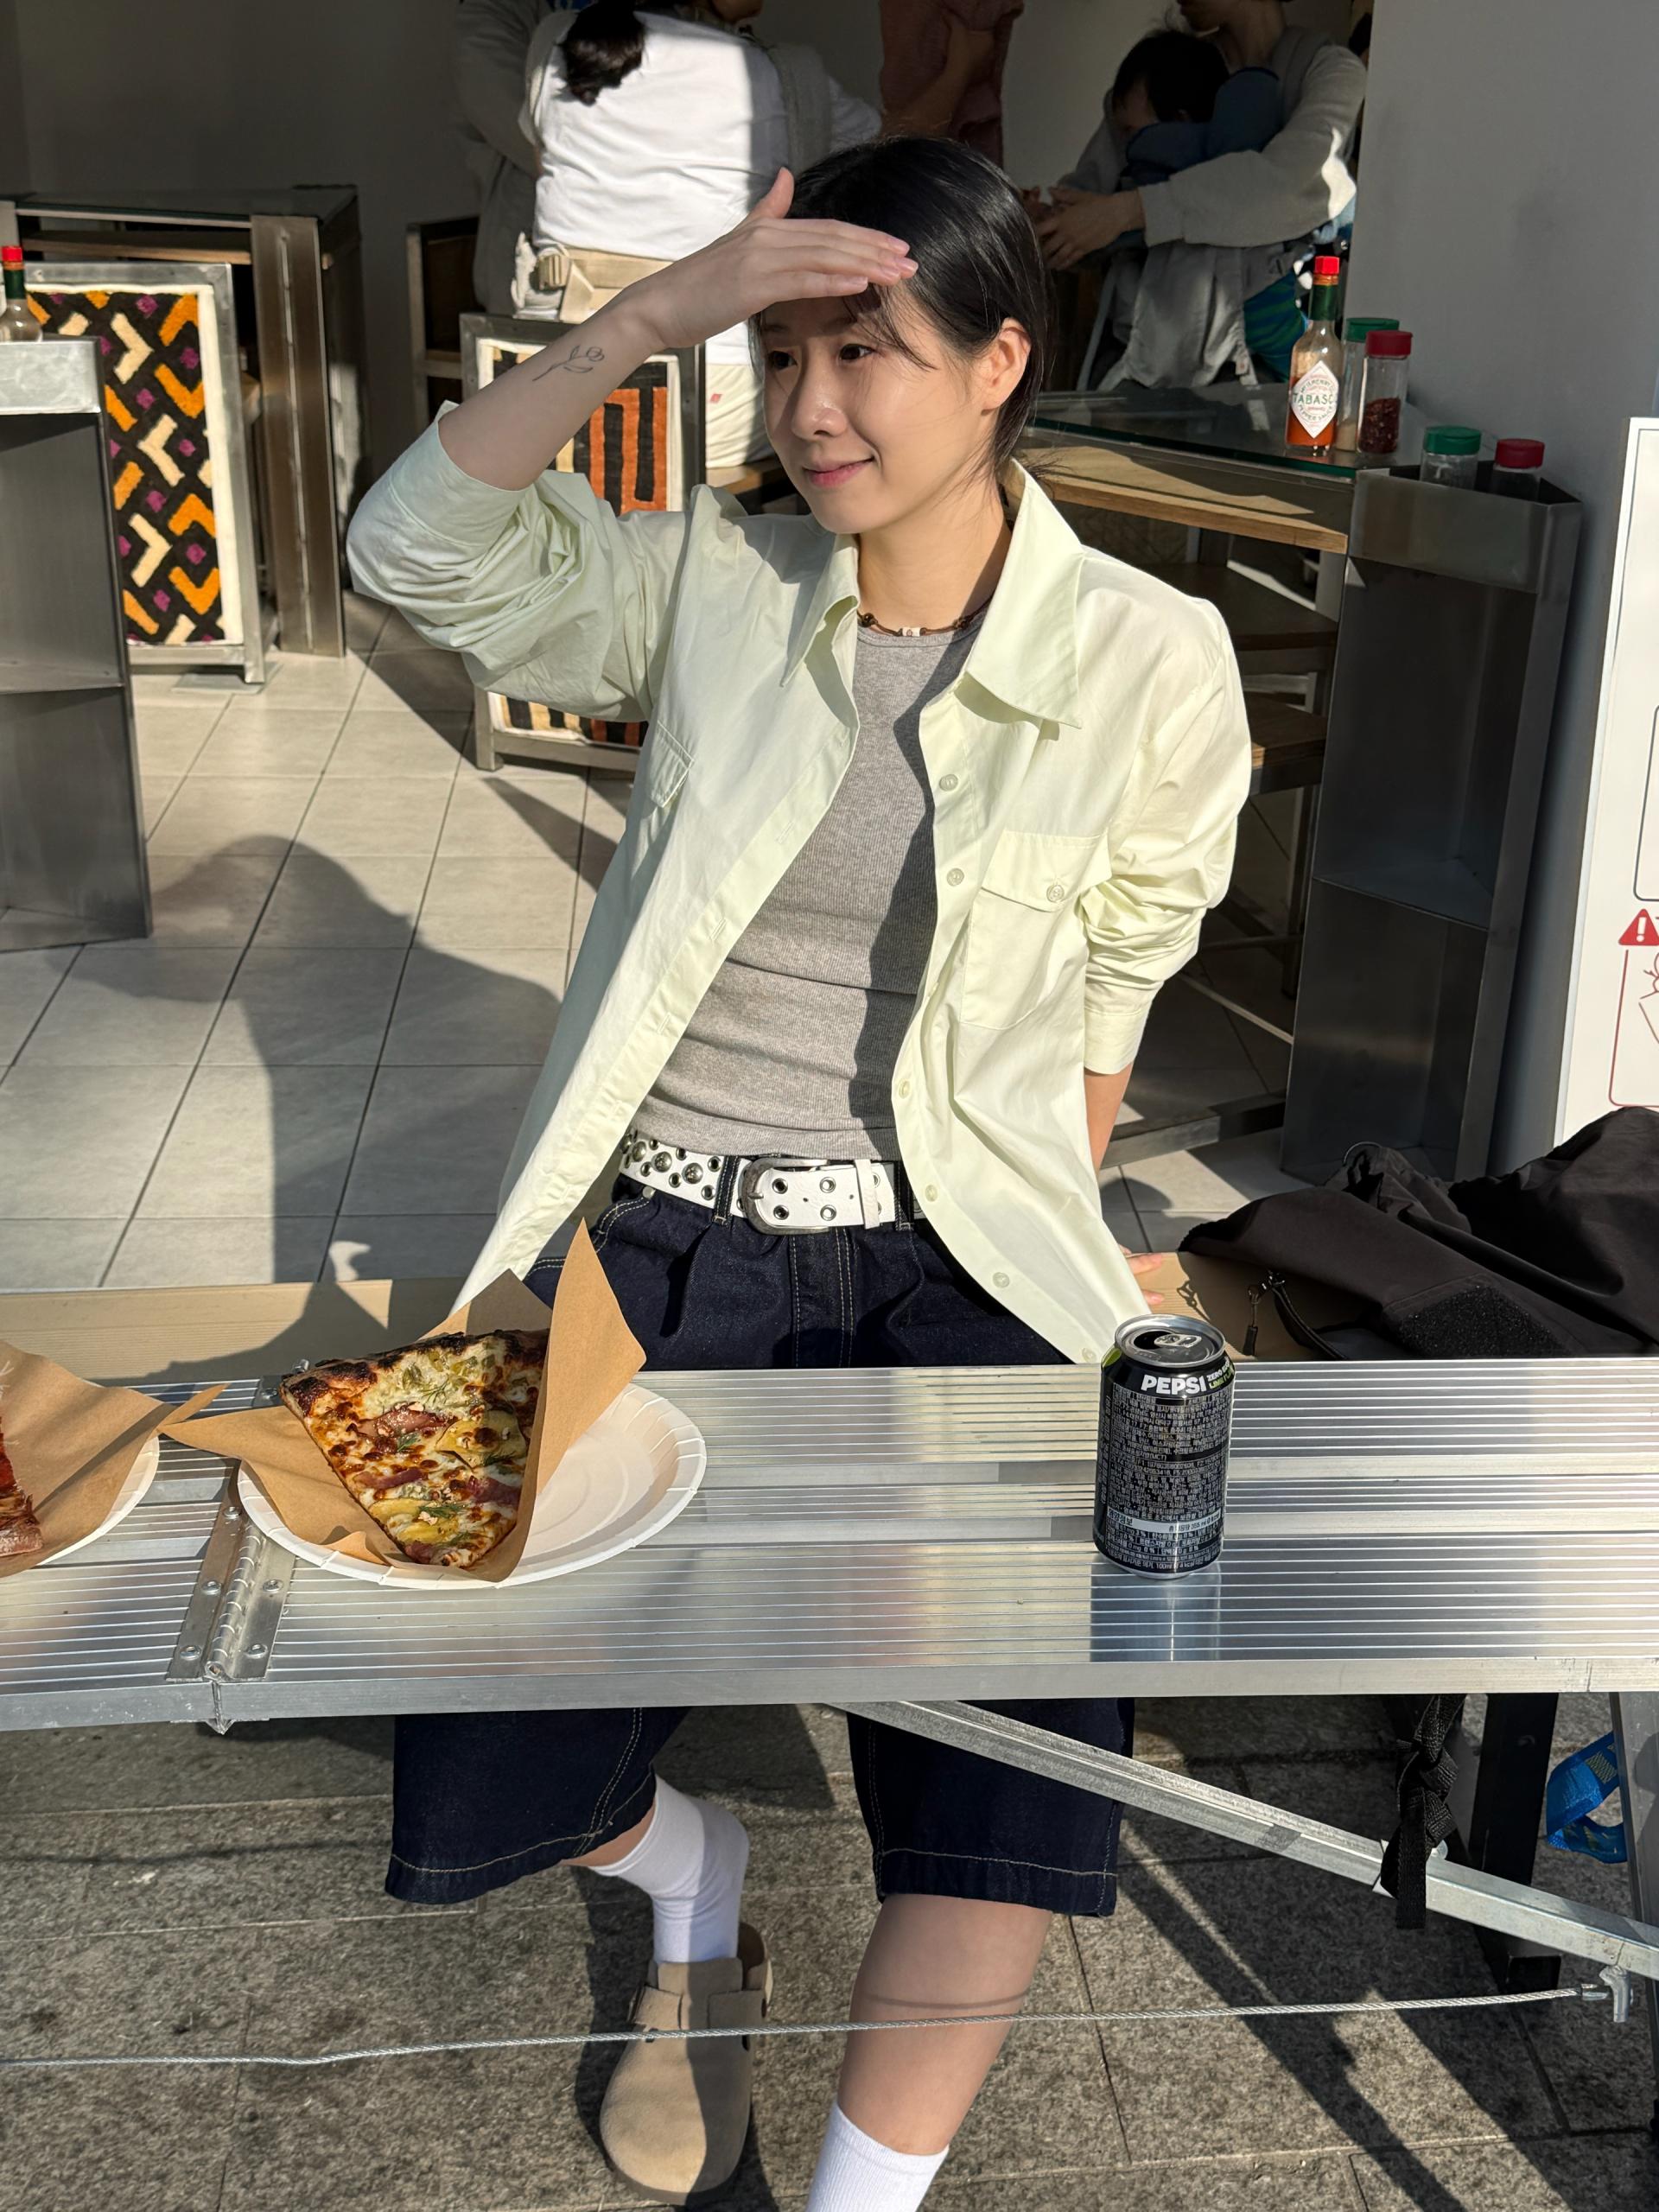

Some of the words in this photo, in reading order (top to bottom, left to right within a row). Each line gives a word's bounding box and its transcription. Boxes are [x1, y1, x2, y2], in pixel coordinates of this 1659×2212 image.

[1293, 391, 1338, 404] TABASC
[1206, 1369, 1223, 1382] ZERO
[1141, 1374, 1207, 1395] PEPSI
